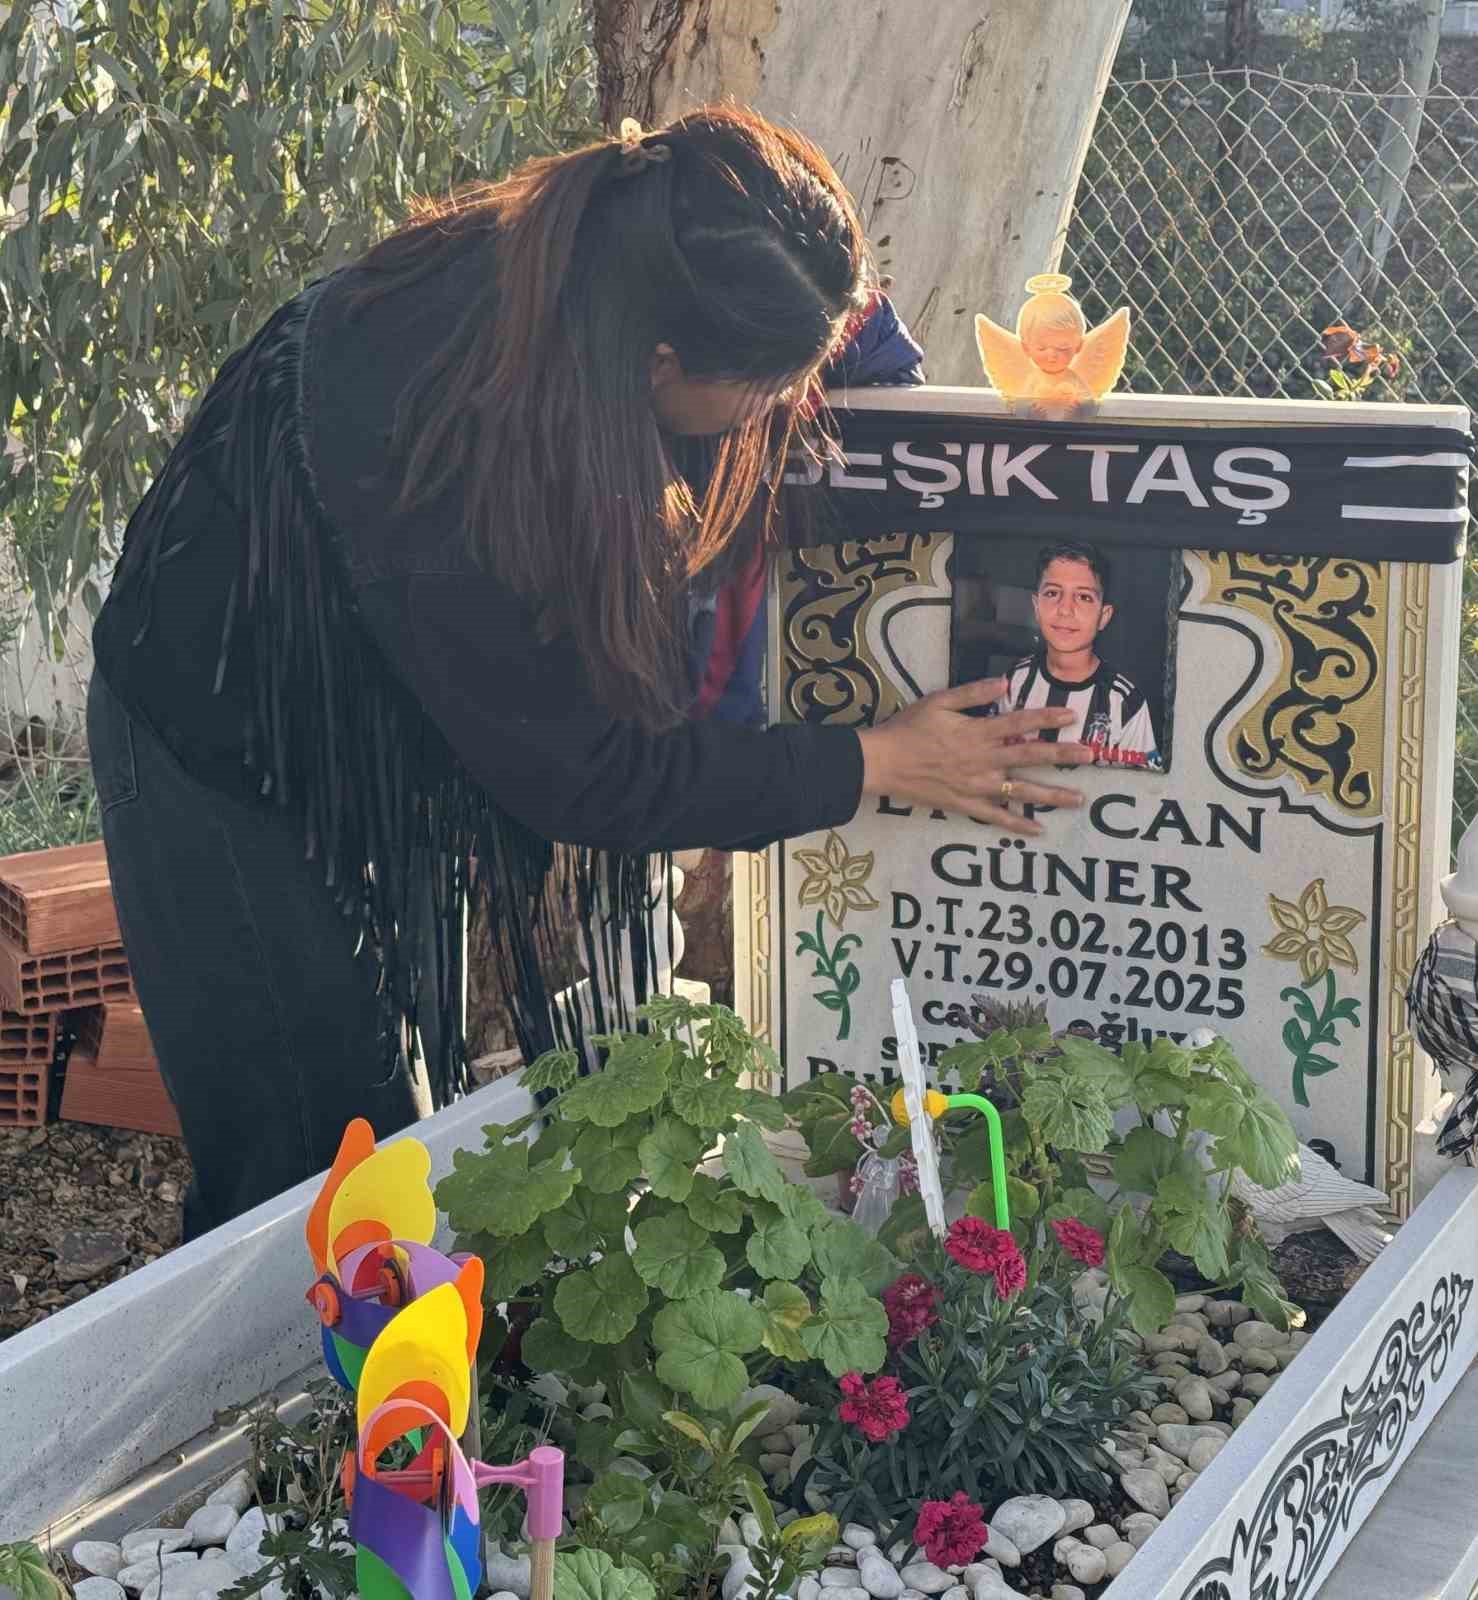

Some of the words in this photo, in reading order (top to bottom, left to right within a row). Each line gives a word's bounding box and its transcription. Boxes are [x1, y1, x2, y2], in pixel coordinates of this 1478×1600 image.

[1089, 793, 1265, 853] CAN
[931, 837, 1203, 912] GÜNER
[890, 891, 1247, 971] D.T.23.02.2013
[890, 937, 1246, 1019] V.T.29.07.2025
